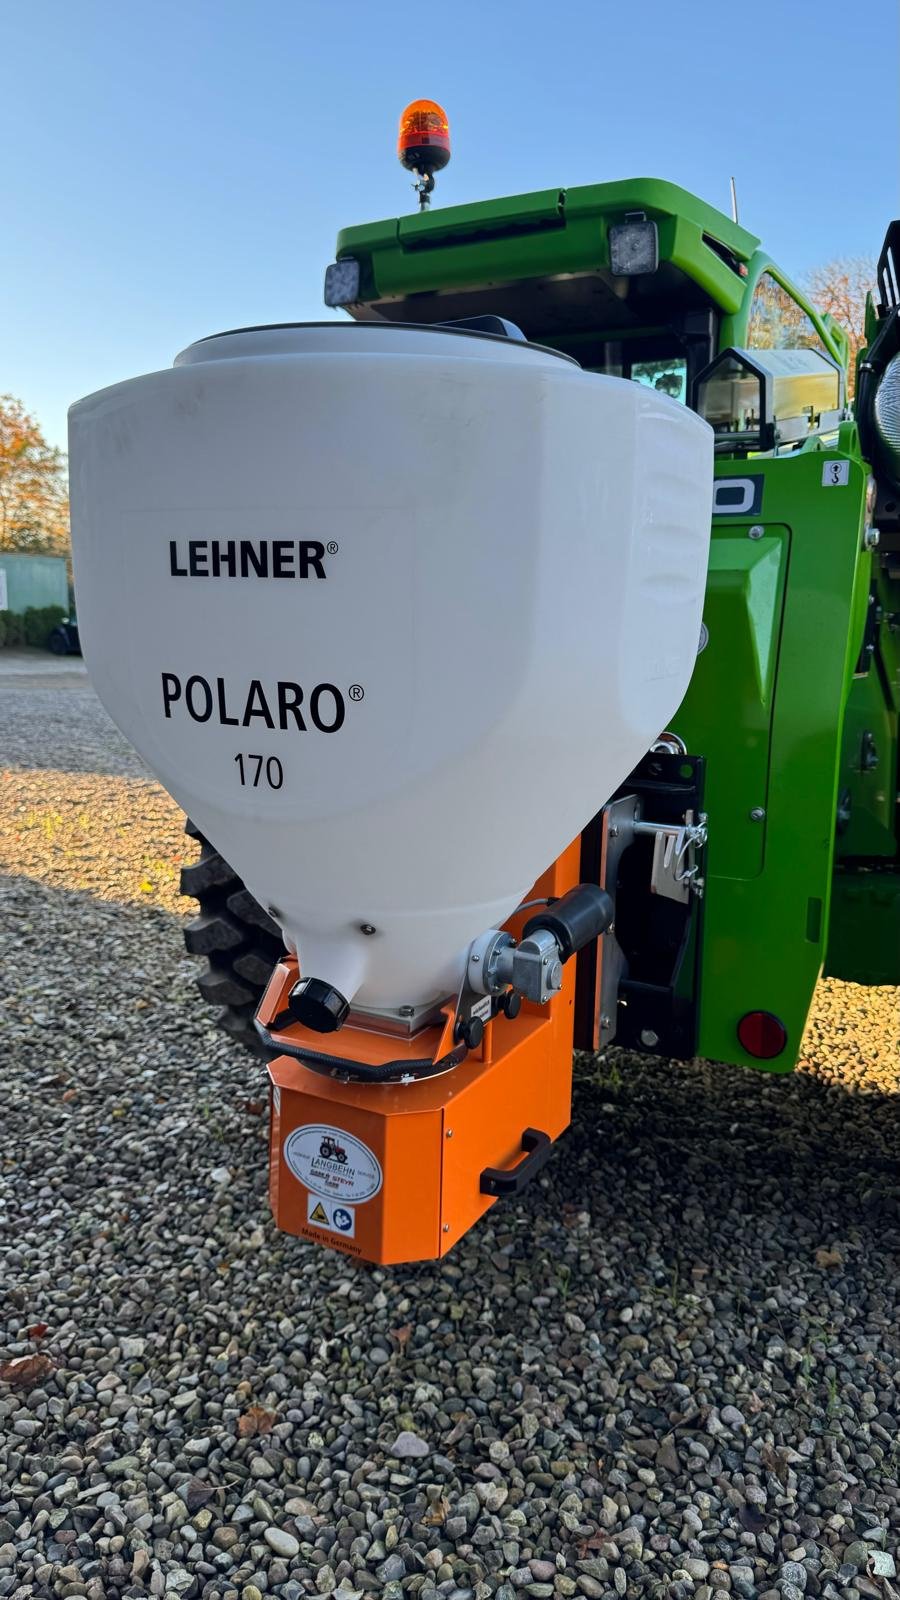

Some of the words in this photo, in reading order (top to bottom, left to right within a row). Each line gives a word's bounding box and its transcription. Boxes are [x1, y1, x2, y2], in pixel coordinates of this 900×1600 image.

[234, 753, 283, 790] 170
[311, 1157, 356, 1176] LANGBEHN
[301, 1228, 321, 1241] Made
[322, 1233, 329, 1243] in
[330, 1235, 362, 1255] Germany
